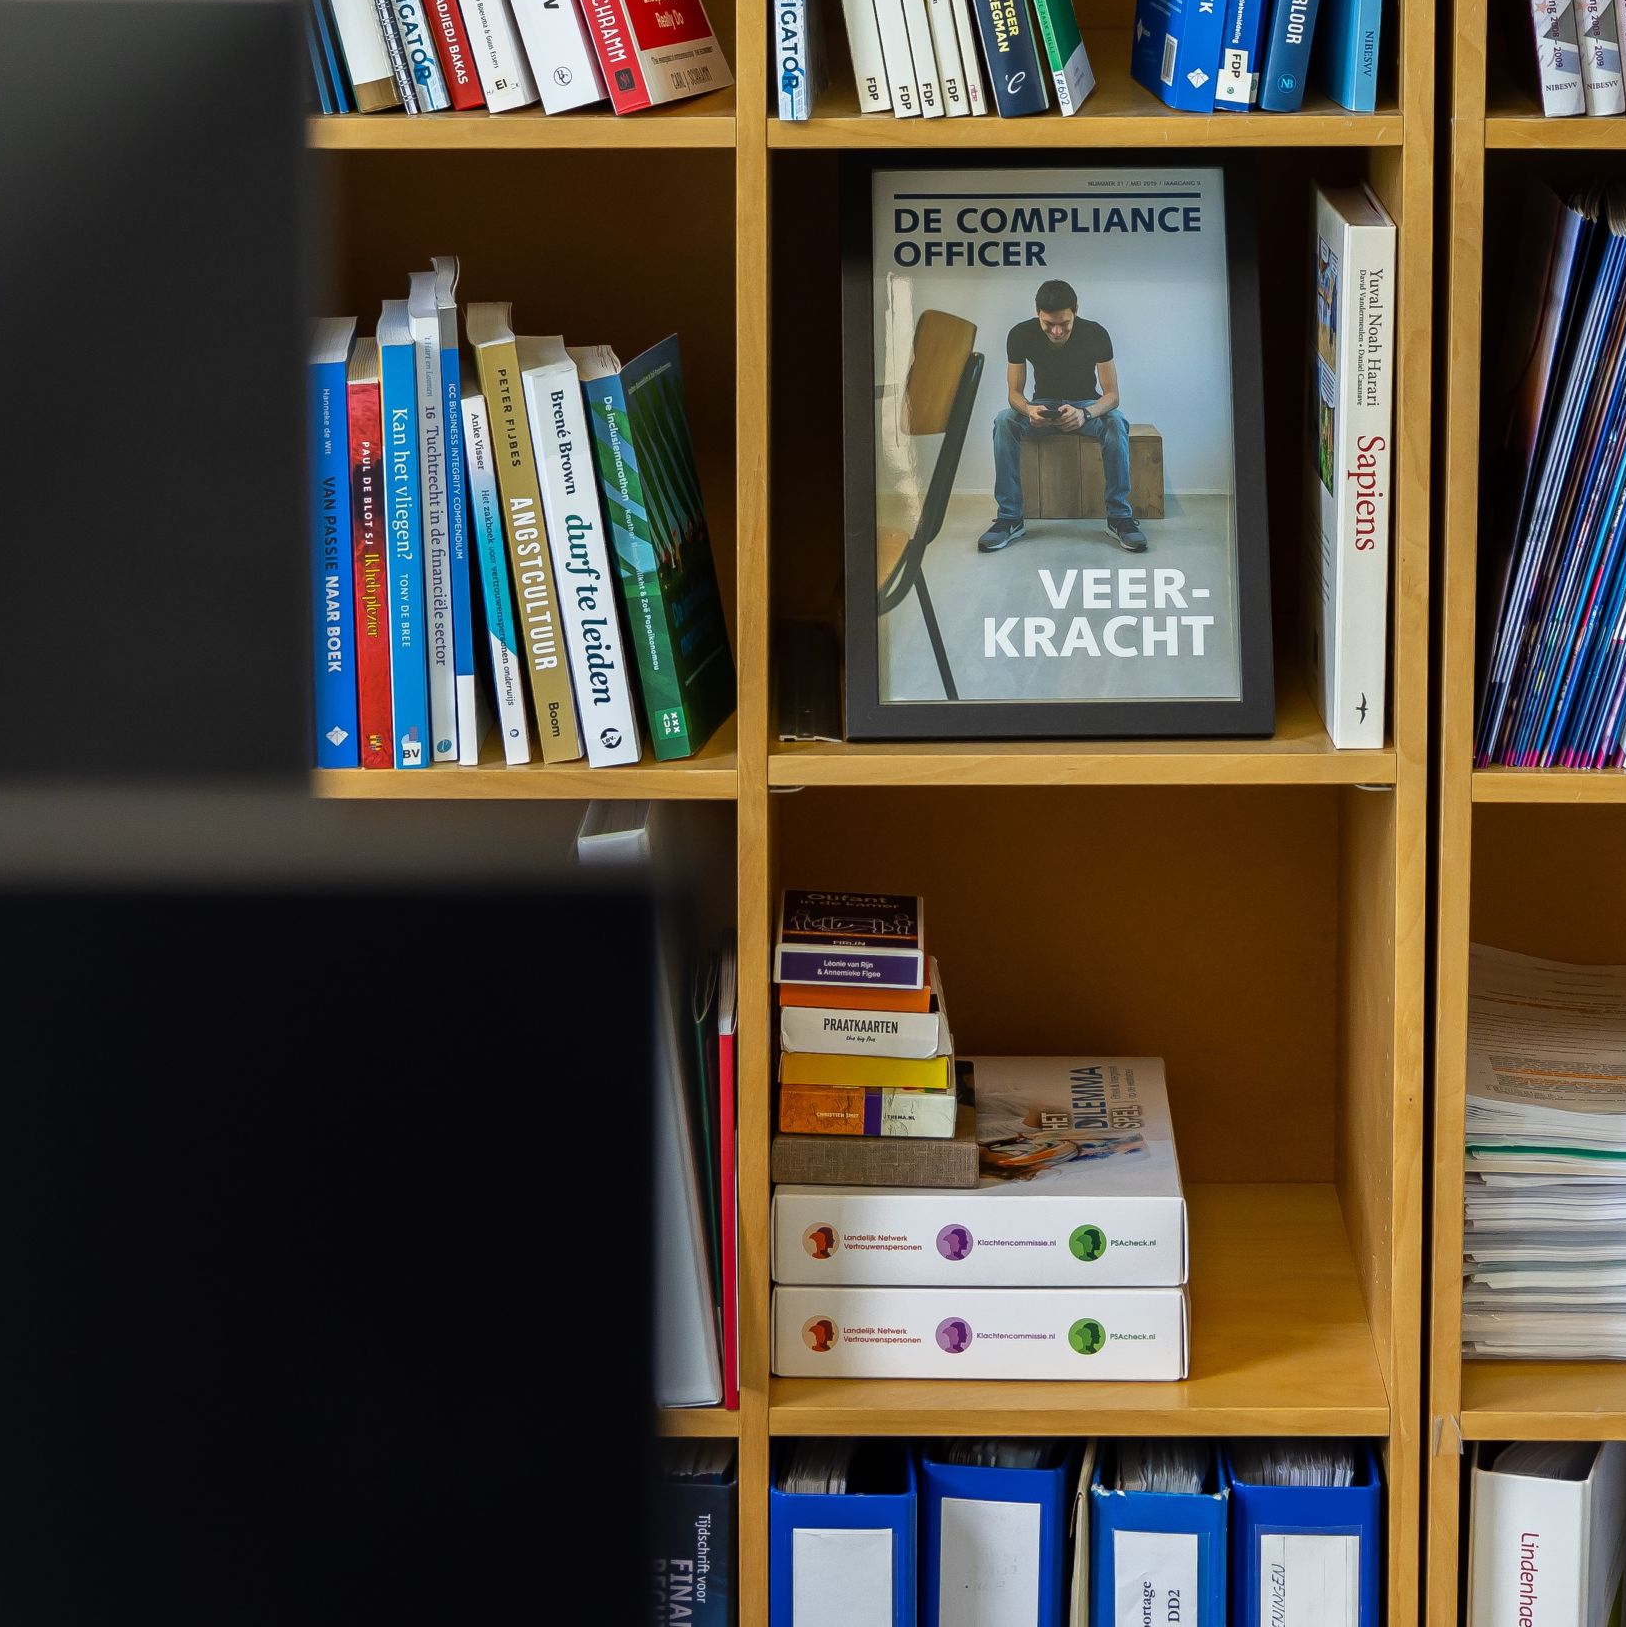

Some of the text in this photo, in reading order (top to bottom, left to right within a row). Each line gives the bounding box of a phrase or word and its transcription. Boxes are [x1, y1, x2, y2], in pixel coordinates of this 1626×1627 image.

[866, 77, 879, 102] FDP
[894, 206, 1202, 234] DE COMPLIANCE
[893, 241, 1047, 267] OFFICER
[1367, 268, 1384, 406] Yuval Noah Harari
[549, 389, 576, 495] Brené Brown
[391, 408, 413, 560] Kan het vliegen?
[1347, 436, 1386, 551] Sapiens
[509, 497, 558, 672] ANGSTCULTUUR
[1038, 568, 1211, 610] VEER-
[564, 512, 612, 705] durf te leiden
[983, 615, 1214, 658] KRACHT
[403, 749, 420, 759] BV
[823, 1017, 898, 1035] PRAATKAARTEN
[843, 1234, 908, 1243] Landelijk Netwerk
[843, 1243, 923, 1253] Vertrouwenspersonen
[977, 1239, 1056, 1247] Klachtencommissie.nl
[1111, 1239, 1156, 1247] PSAcheck.nl
[695, 1514, 711, 1603] Tijdschrift voor
[1168, 1590, 1180, 1622] DD2
